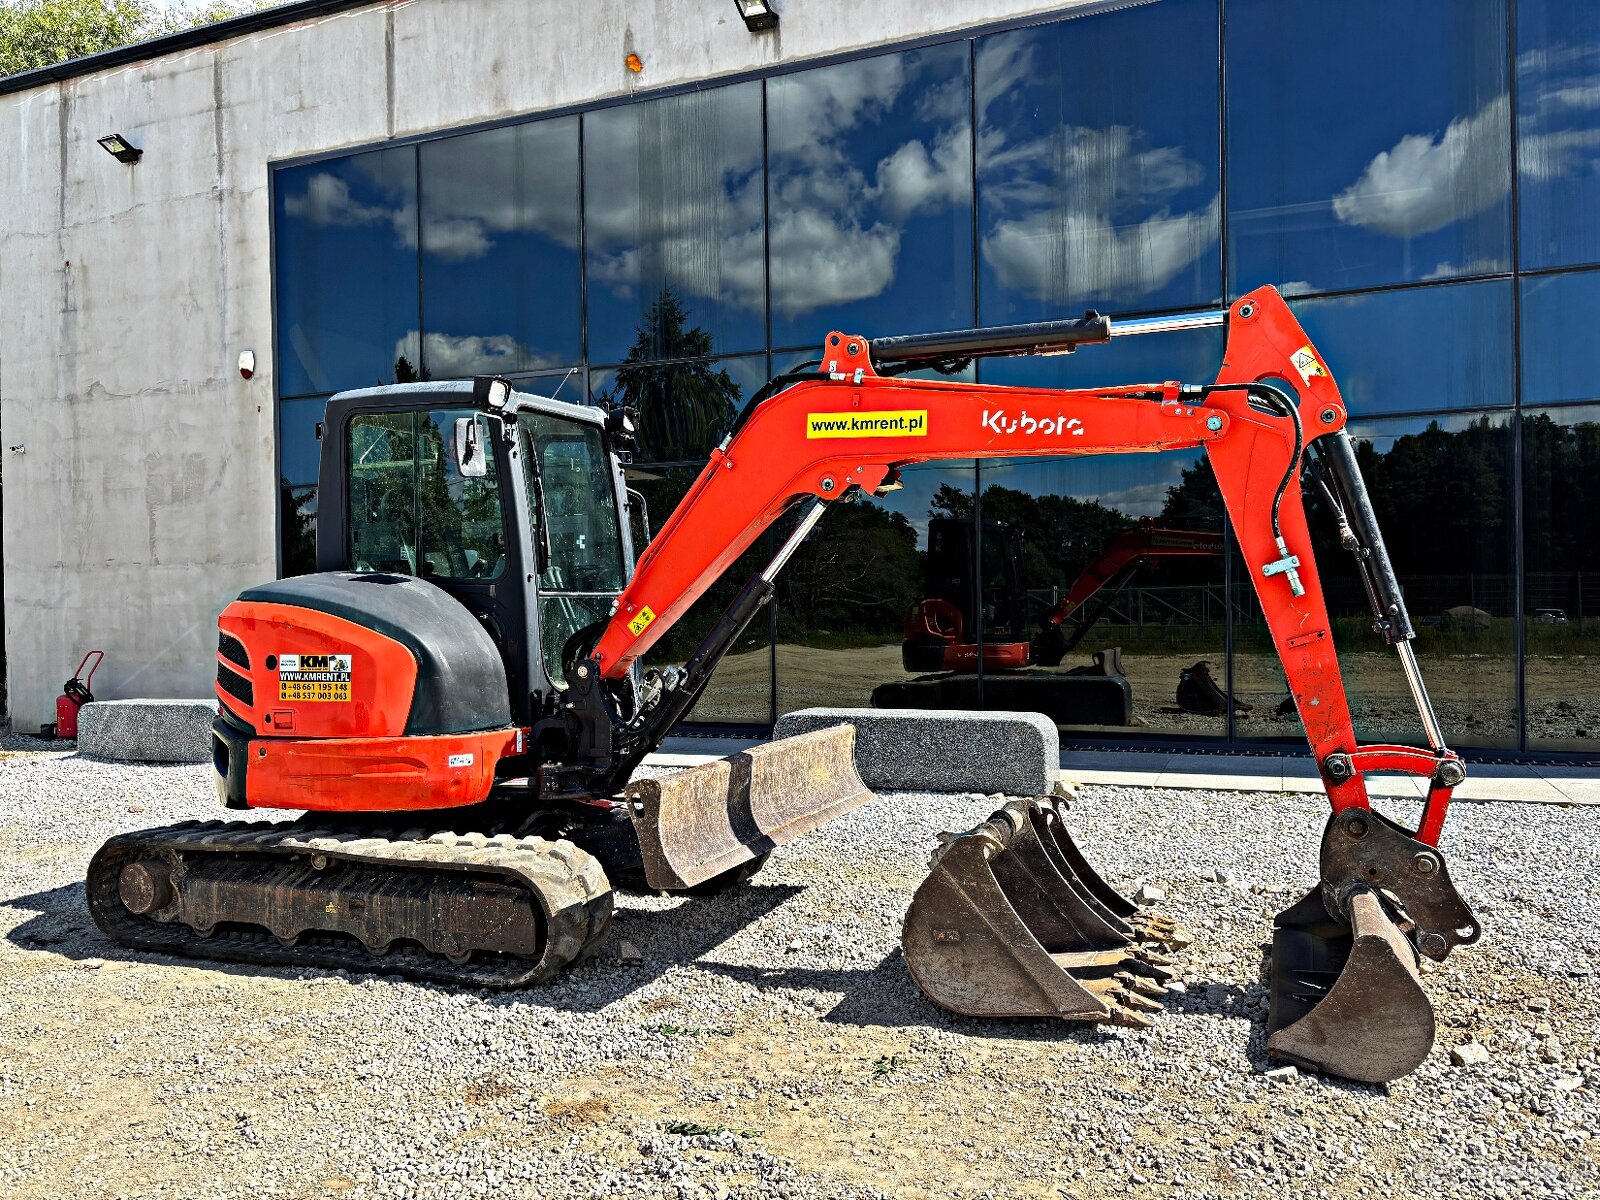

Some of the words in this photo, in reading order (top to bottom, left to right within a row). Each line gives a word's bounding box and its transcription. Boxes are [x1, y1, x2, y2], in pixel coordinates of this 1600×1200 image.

[811, 415, 923, 432] www.kmrent.pl
[982, 409, 1085, 436] Kubota
[300, 655, 328, 667] KM
[279, 672, 350, 682] WWW.KMRENT.PL
[302, 683, 315, 691] 661
[318, 683, 332, 691] 195
[334, 683, 348, 691] 148
[317, 692, 332, 700] 003
[334, 692, 347, 700] 063
